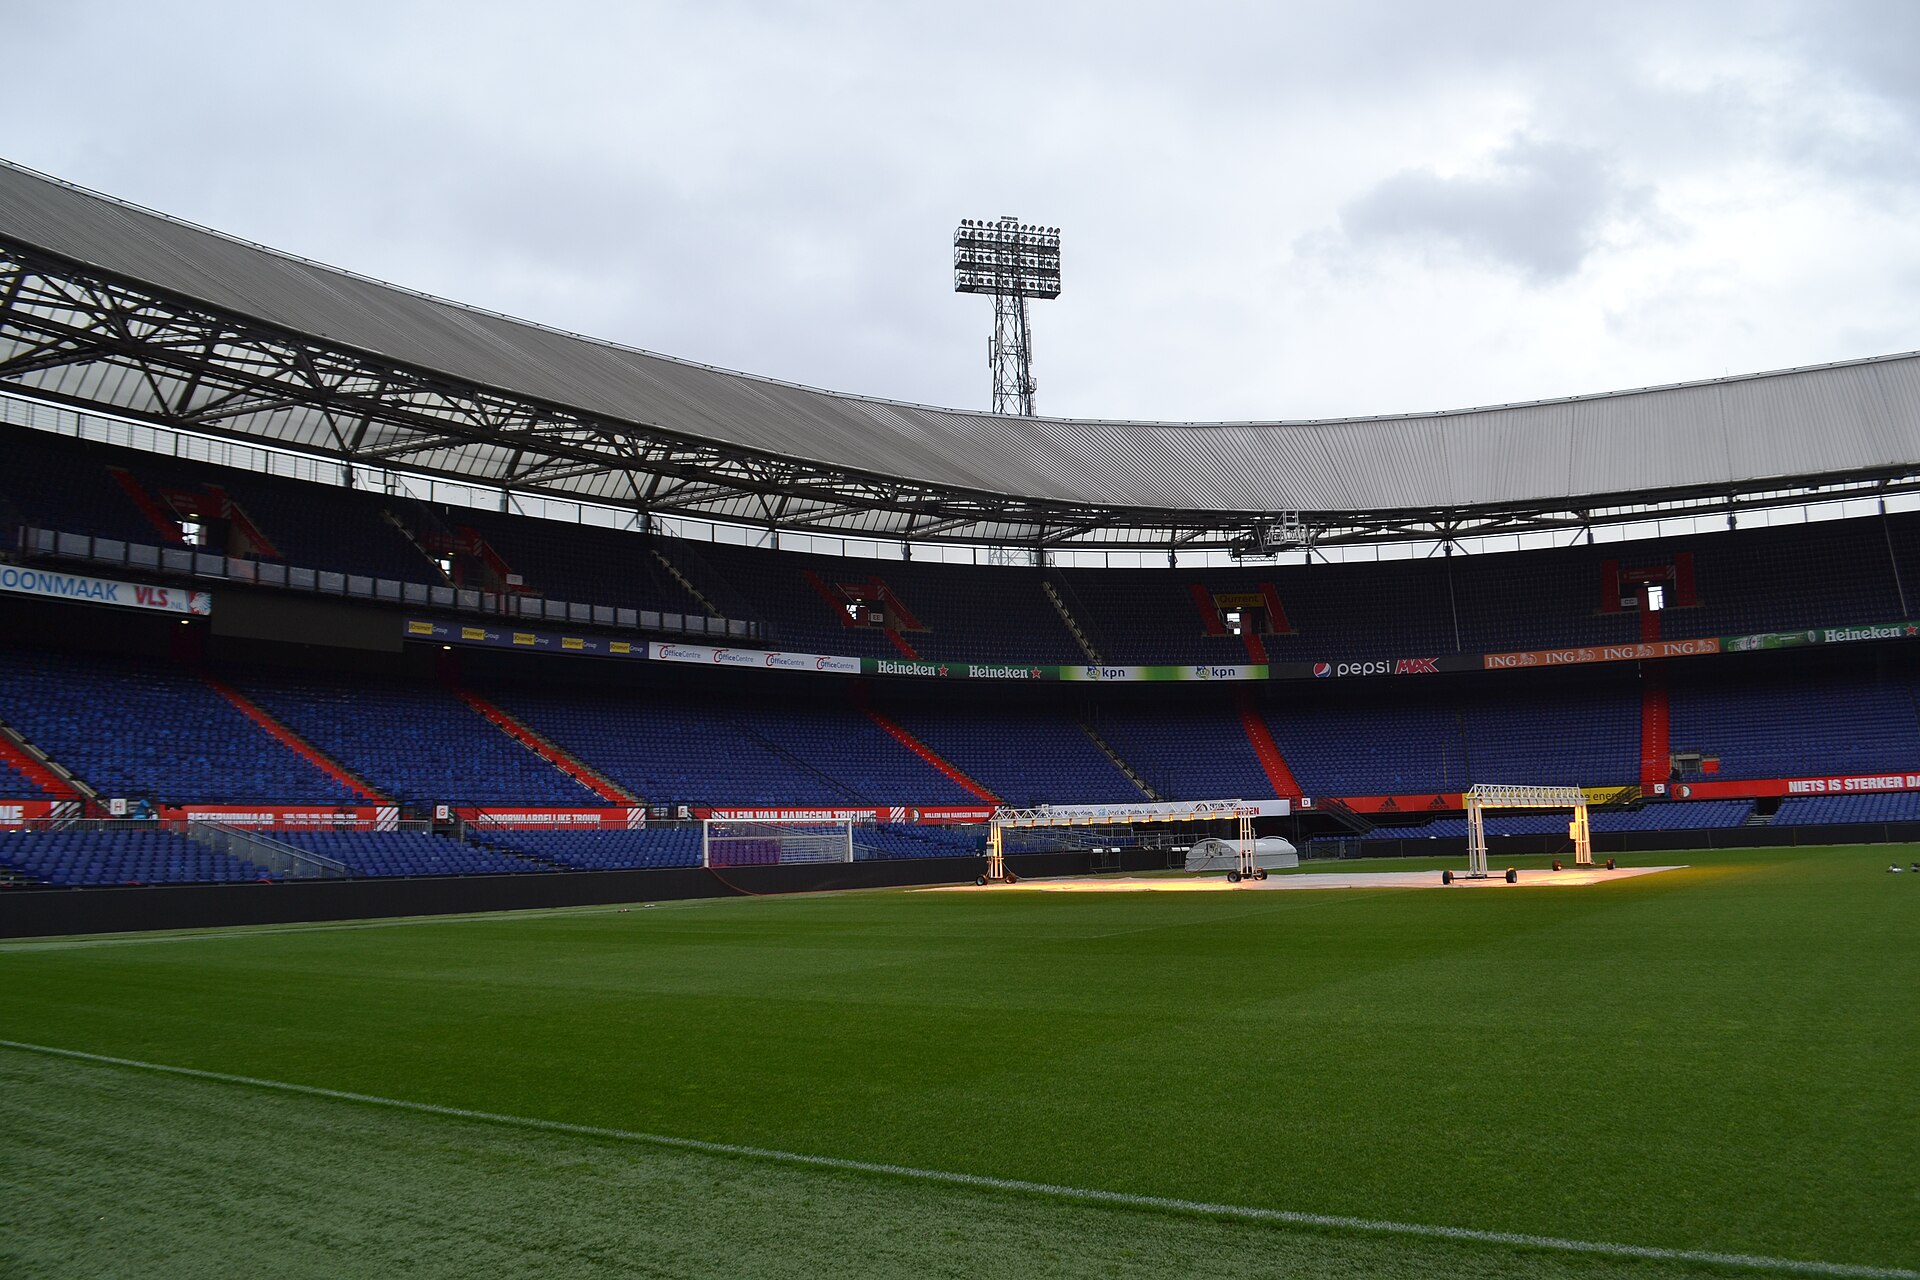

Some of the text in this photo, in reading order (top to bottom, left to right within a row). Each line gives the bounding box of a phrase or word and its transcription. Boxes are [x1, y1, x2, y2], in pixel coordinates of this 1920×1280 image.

[1824, 626, 1901, 643] Heineken
[1603, 647, 1633, 659] ING
[1663, 643, 1694, 655] ING
[1488, 655, 1517, 667] ING
[1545, 651, 1575, 664] ING
[877, 660, 935, 676] Heineken
[969, 665, 1028, 679] Heineken
[1102, 667, 1126, 680] kpn
[1212, 667, 1236, 679] kpn
[1337, 657, 1440, 677] pepsi MAX
[1788, 780, 1825, 793] NIETS
[1828, 779, 1842, 791] IS
[1844, 776, 1903, 790] STERKER
[114, 802, 122, 812] H
